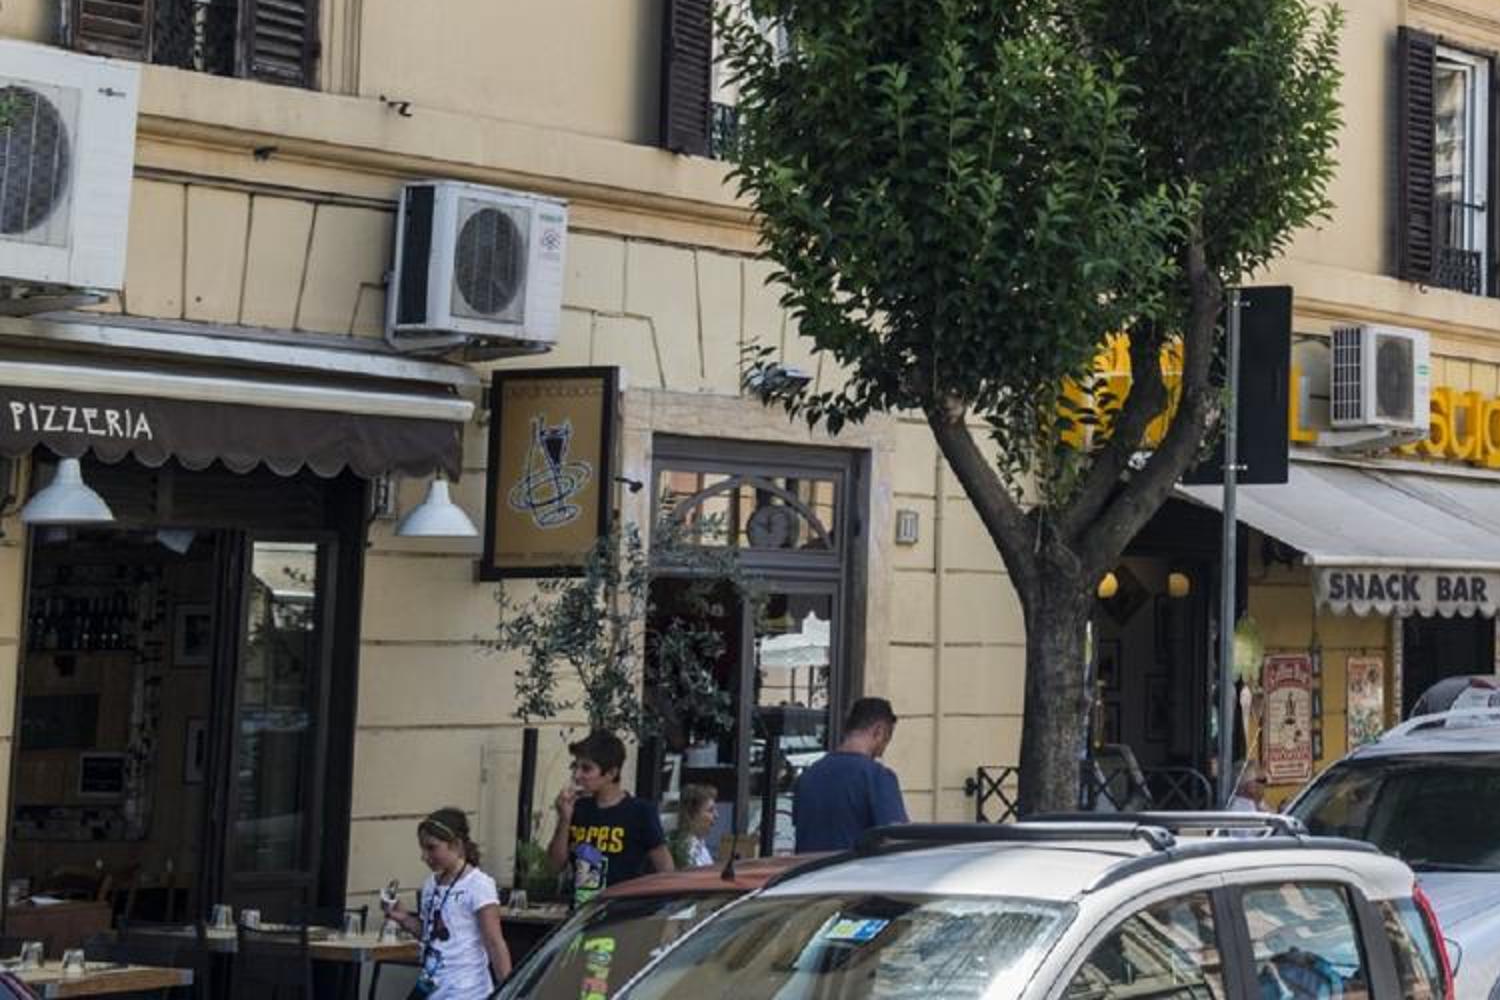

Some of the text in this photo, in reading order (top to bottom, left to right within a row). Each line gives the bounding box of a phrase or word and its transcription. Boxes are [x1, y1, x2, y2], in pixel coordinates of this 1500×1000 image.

[9, 401, 153, 440] PIZZERIA
[1328, 573, 1421, 601] SNACK
[1436, 577, 1489, 602] BAR
